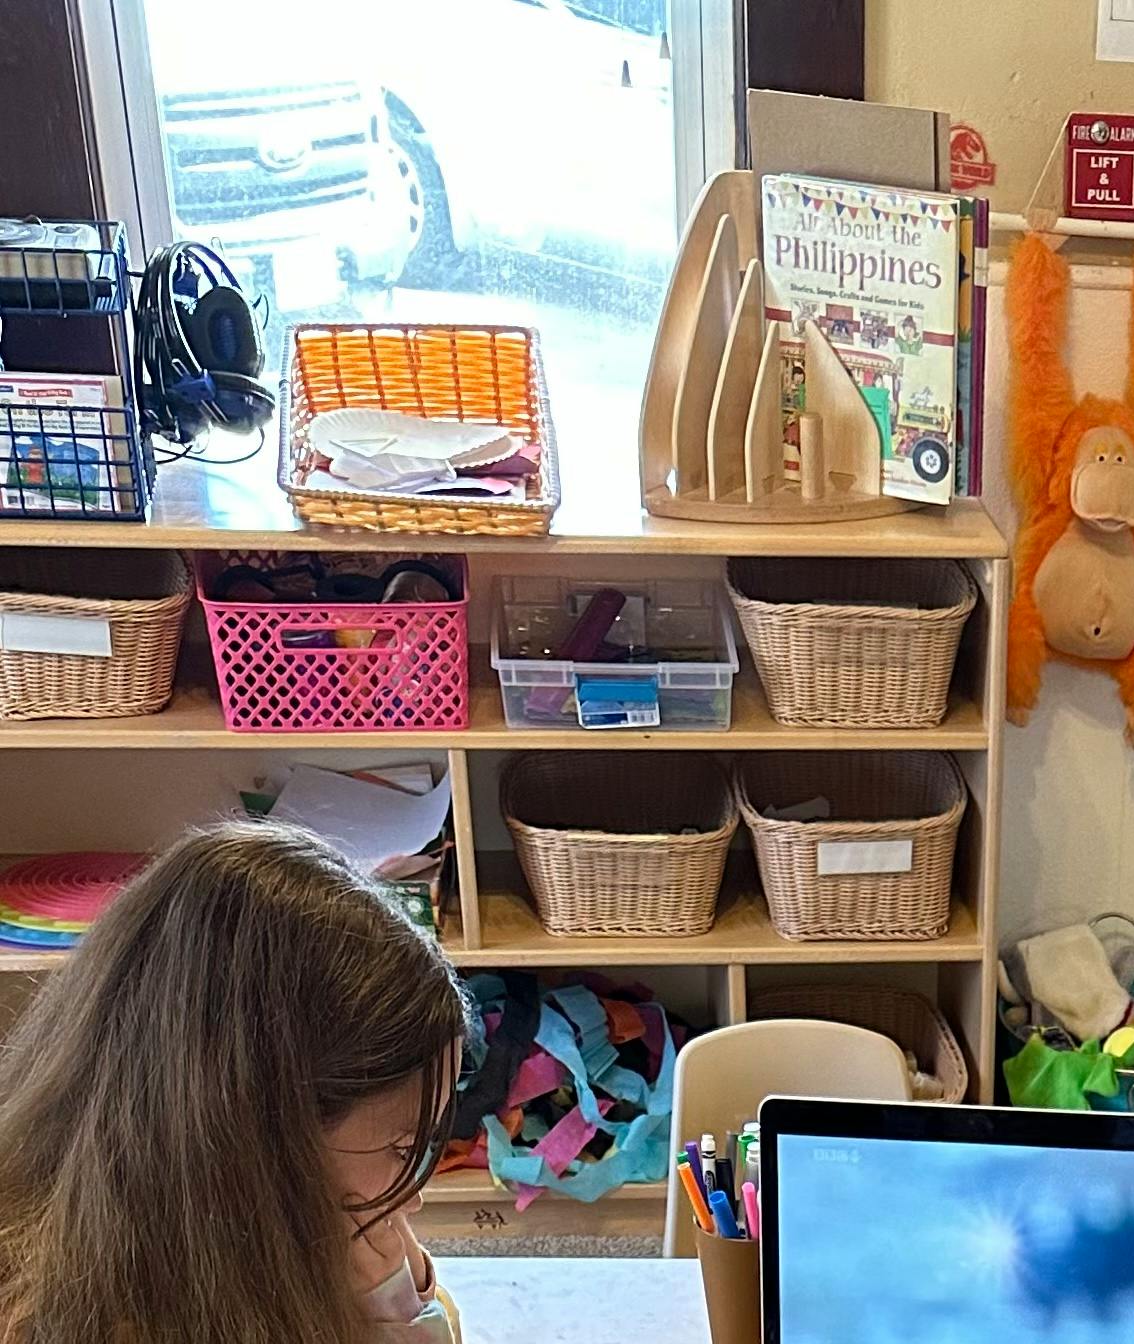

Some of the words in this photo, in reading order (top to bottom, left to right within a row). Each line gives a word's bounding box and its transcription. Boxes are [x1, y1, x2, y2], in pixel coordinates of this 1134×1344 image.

[1072, 125, 1091, 140] FIRE
[1090, 156, 1119, 169] LIFT
[1099, 172, 1109, 185] &
[1087, 188, 1120, 201] PULL
[832, 215, 884, 245] About
[892, 222, 922, 248] the
[774, 233, 942, 290] Philippines
